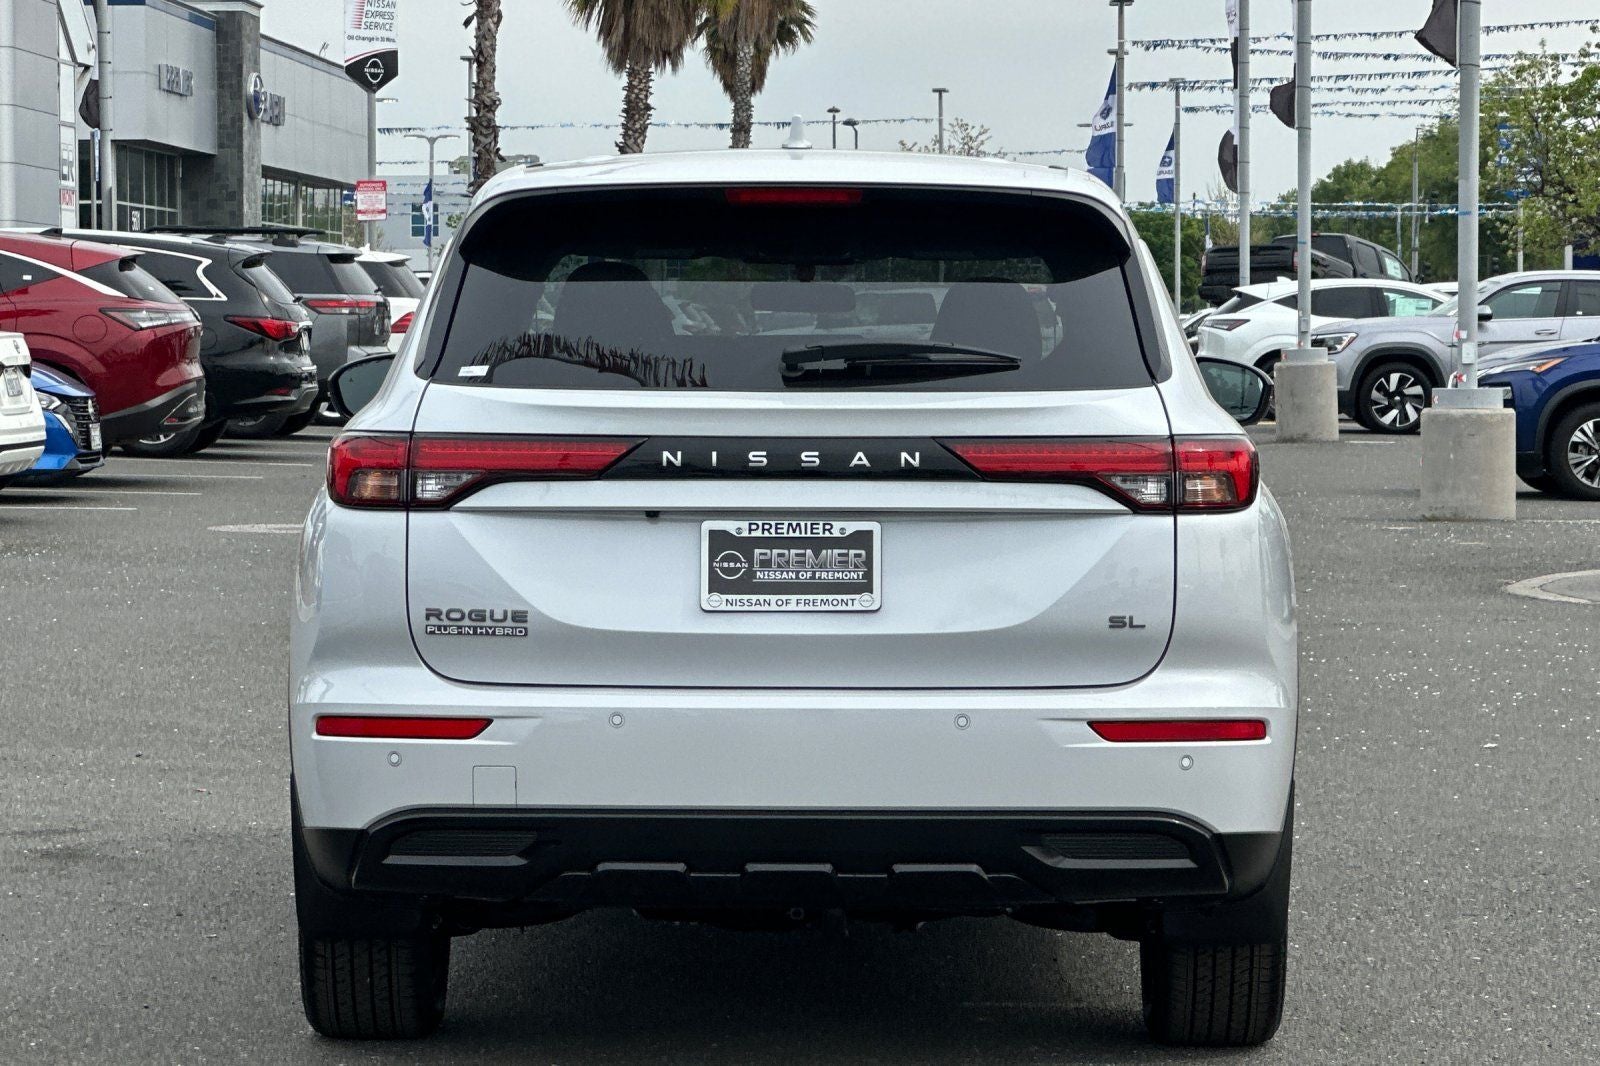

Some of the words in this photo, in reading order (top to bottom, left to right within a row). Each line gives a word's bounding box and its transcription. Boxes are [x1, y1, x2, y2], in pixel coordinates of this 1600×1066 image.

[366, 0, 396, 9] NISSAN
[365, 10, 394, 20] EXPRESS
[363, 21, 393, 31] SERVICE
[662, 450, 920, 468] NISSAN
[748, 522, 834, 535] PREMIER
[753, 548, 868, 569] PREMIER
[756, 571, 796, 580] NISSAN
[800, 571, 812, 580] OF
[815, 571, 864, 580] FREMONT
[725, 598, 771, 607] NISSAN
[775, 598, 793, 607] OF
[796, 598, 857, 607] FREMONT
[425, 608, 528, 623] ROGUE
[1109, 615, 1146, 629] SL
[427, 626, 473, 635] PLUG-IN
[477, 627, 525, 636] HYBRID
